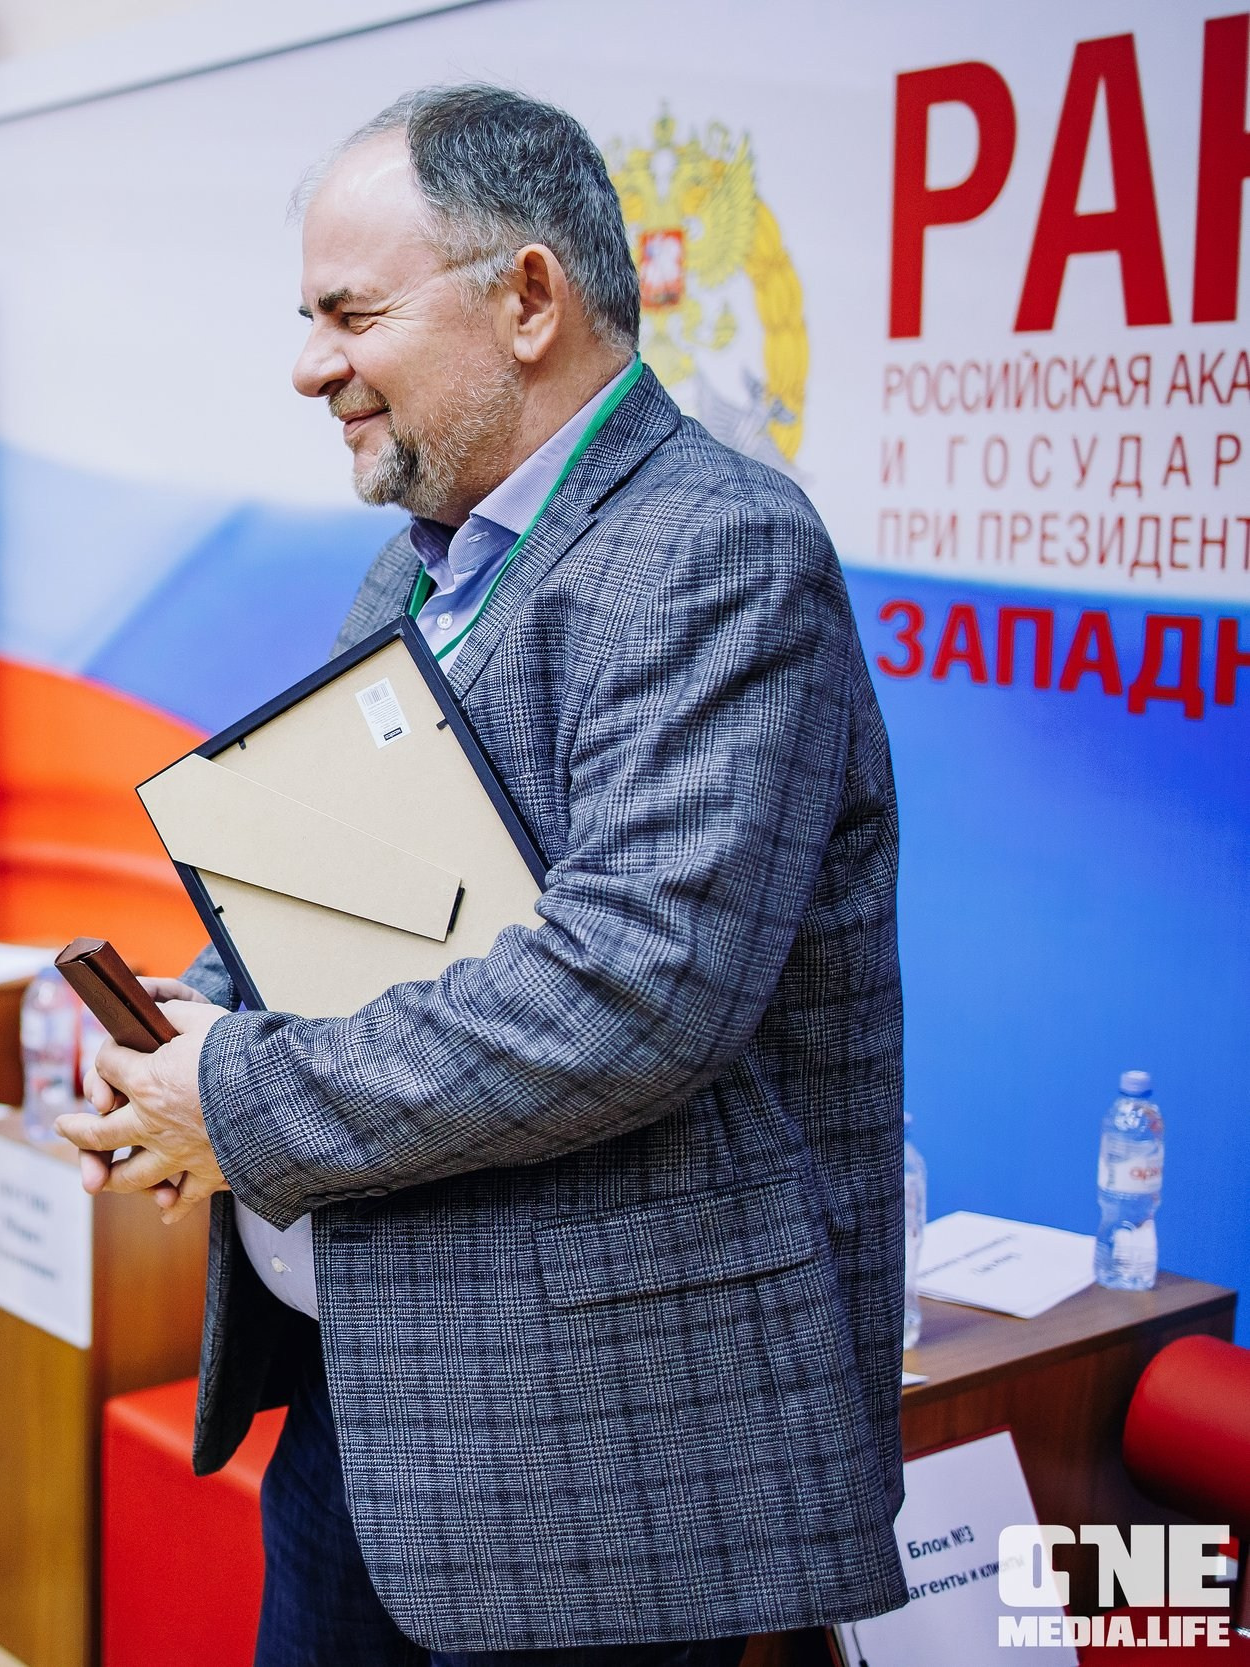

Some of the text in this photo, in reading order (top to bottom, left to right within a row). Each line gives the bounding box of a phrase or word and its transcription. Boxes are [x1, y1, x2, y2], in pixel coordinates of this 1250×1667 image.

[883, 350, 1152, 414] РОССИЙСКАЯ
[881, 433, 1242, 499] И ГОСУДАР
[876, 509, 958, 562] ПРИ
[907, 1525, 975, 1559] Блок №3
[909, 1571, 969, 1600] агенты
[969, 1568, 980, 1582] и
